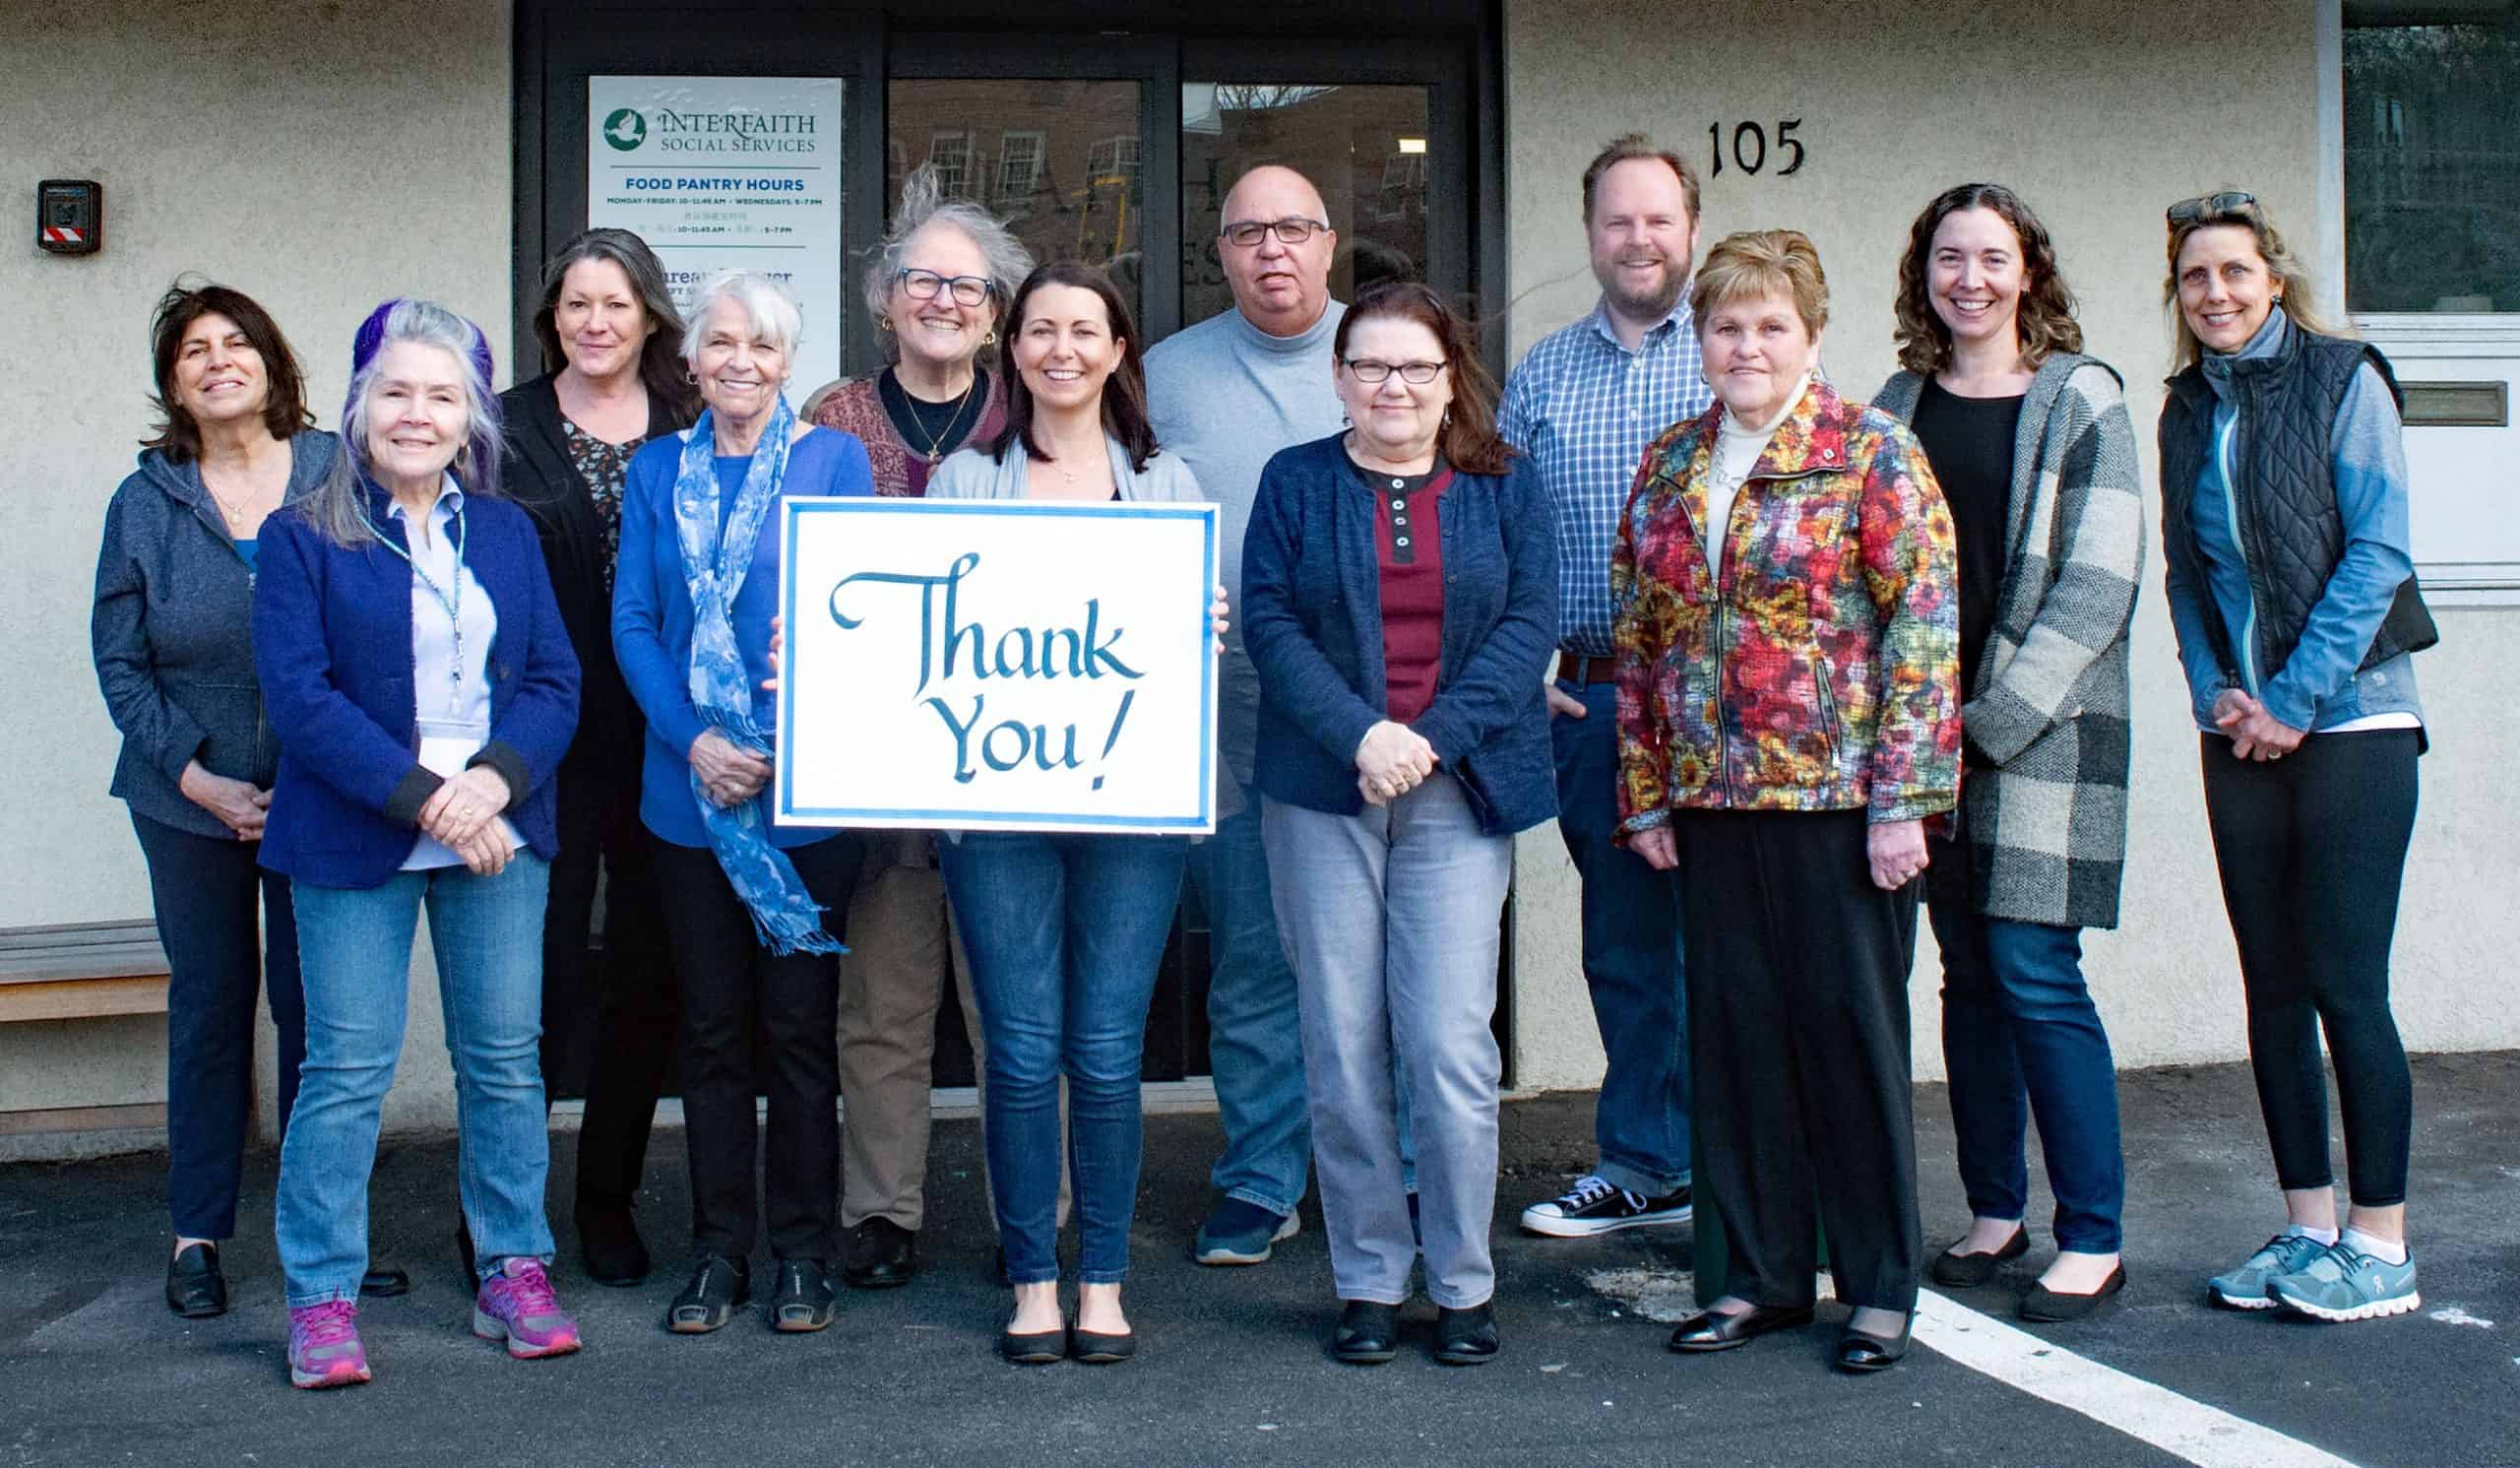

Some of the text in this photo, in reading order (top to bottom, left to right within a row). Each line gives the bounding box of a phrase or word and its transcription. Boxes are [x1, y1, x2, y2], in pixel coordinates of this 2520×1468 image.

[658, 108, 816, 140] INTERFAITH
[662, 138, 816, 153] SOCIAL SERVICES
[1708, 117, 1804, 179] 105
[626, 178, 804, 191] FOOD PANTRY HOURS
[828, 551, 1147, 700] Thank
[919, 689, 1136, 791] You!
